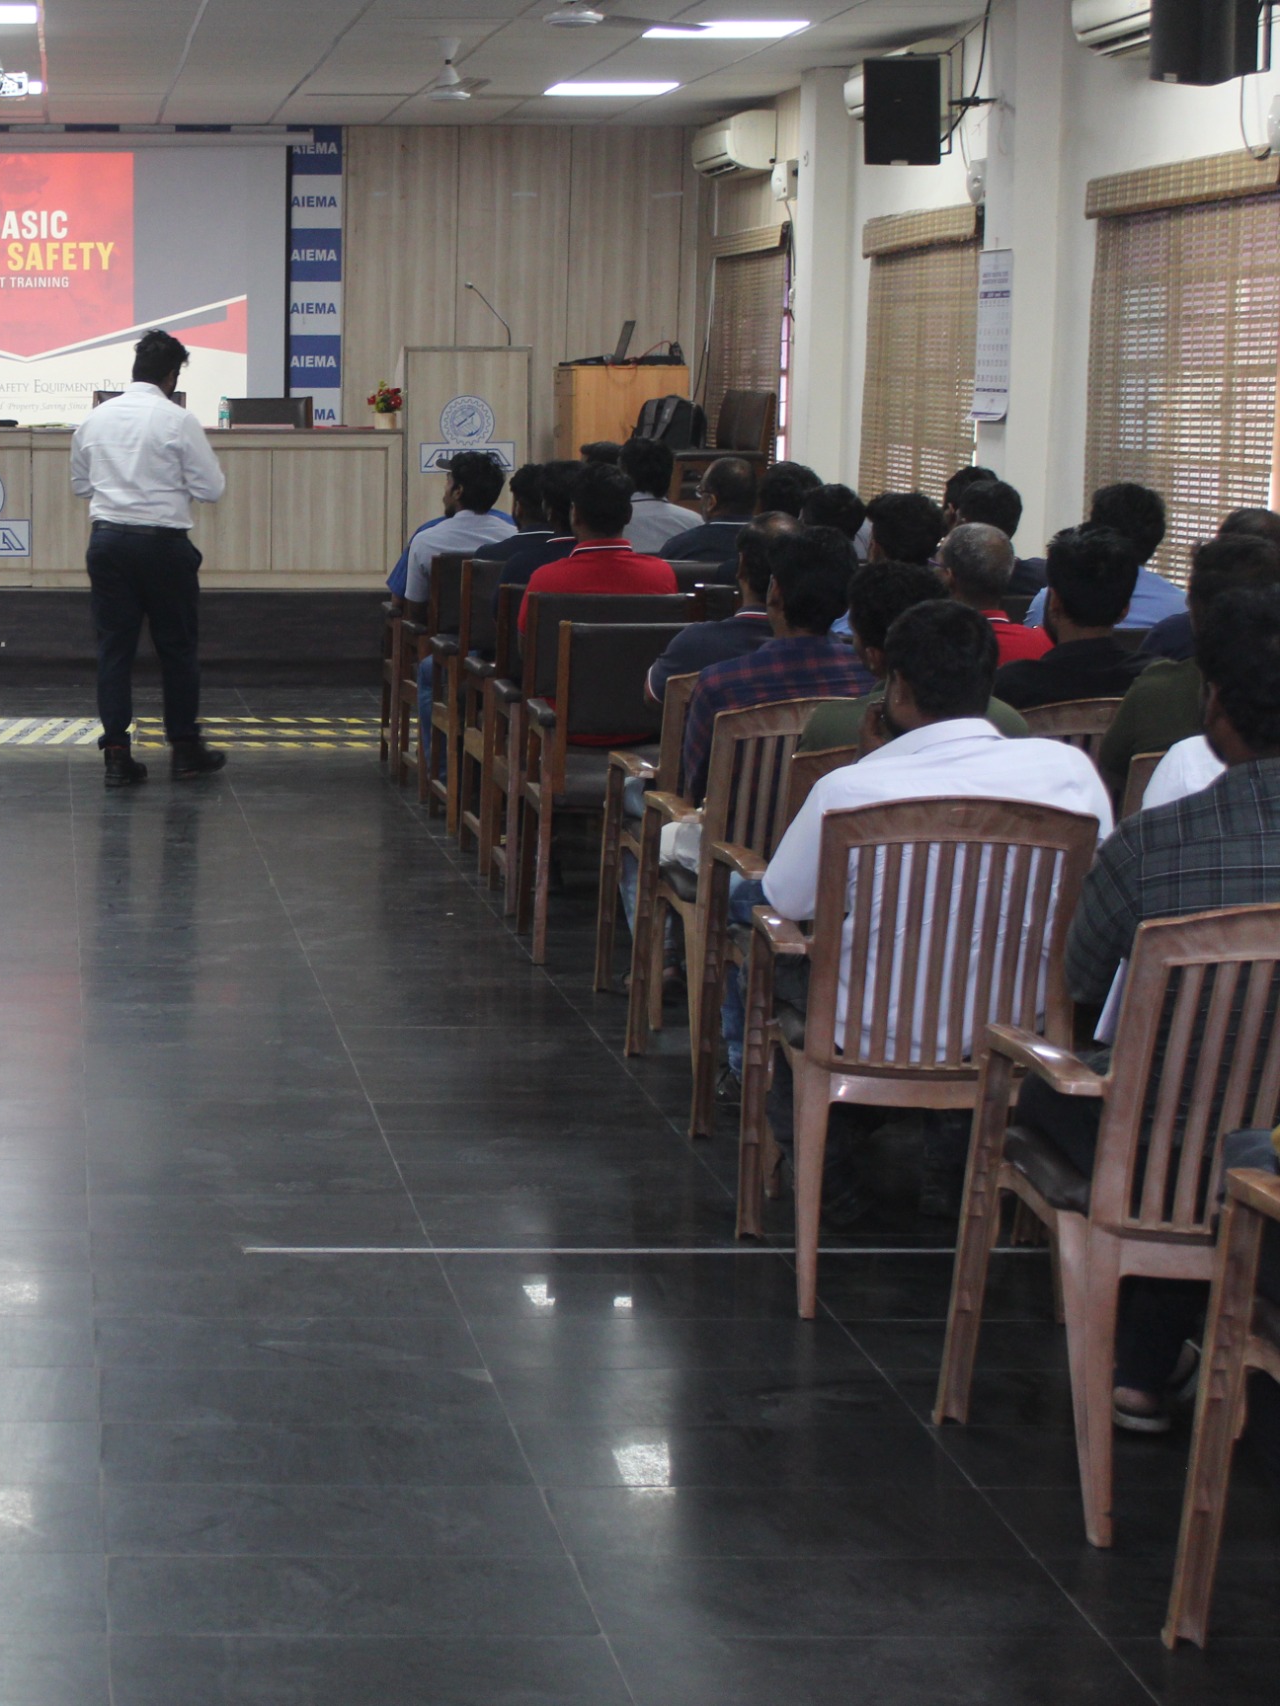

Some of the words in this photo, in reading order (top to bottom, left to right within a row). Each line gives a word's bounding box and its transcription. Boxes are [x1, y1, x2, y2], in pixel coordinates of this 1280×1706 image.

[292, 142, 338, 155] AIEMA
[291, 196, 337, 208] AIEMA
[7, 242, 115, 271] SAFETY
[290, 249, 337, 262] AIEMA
[10, 276, 70, 288] TRAINING
[290, 303, 337, 315] AIEMA
[290, 355, 337, 368] AIEMA
